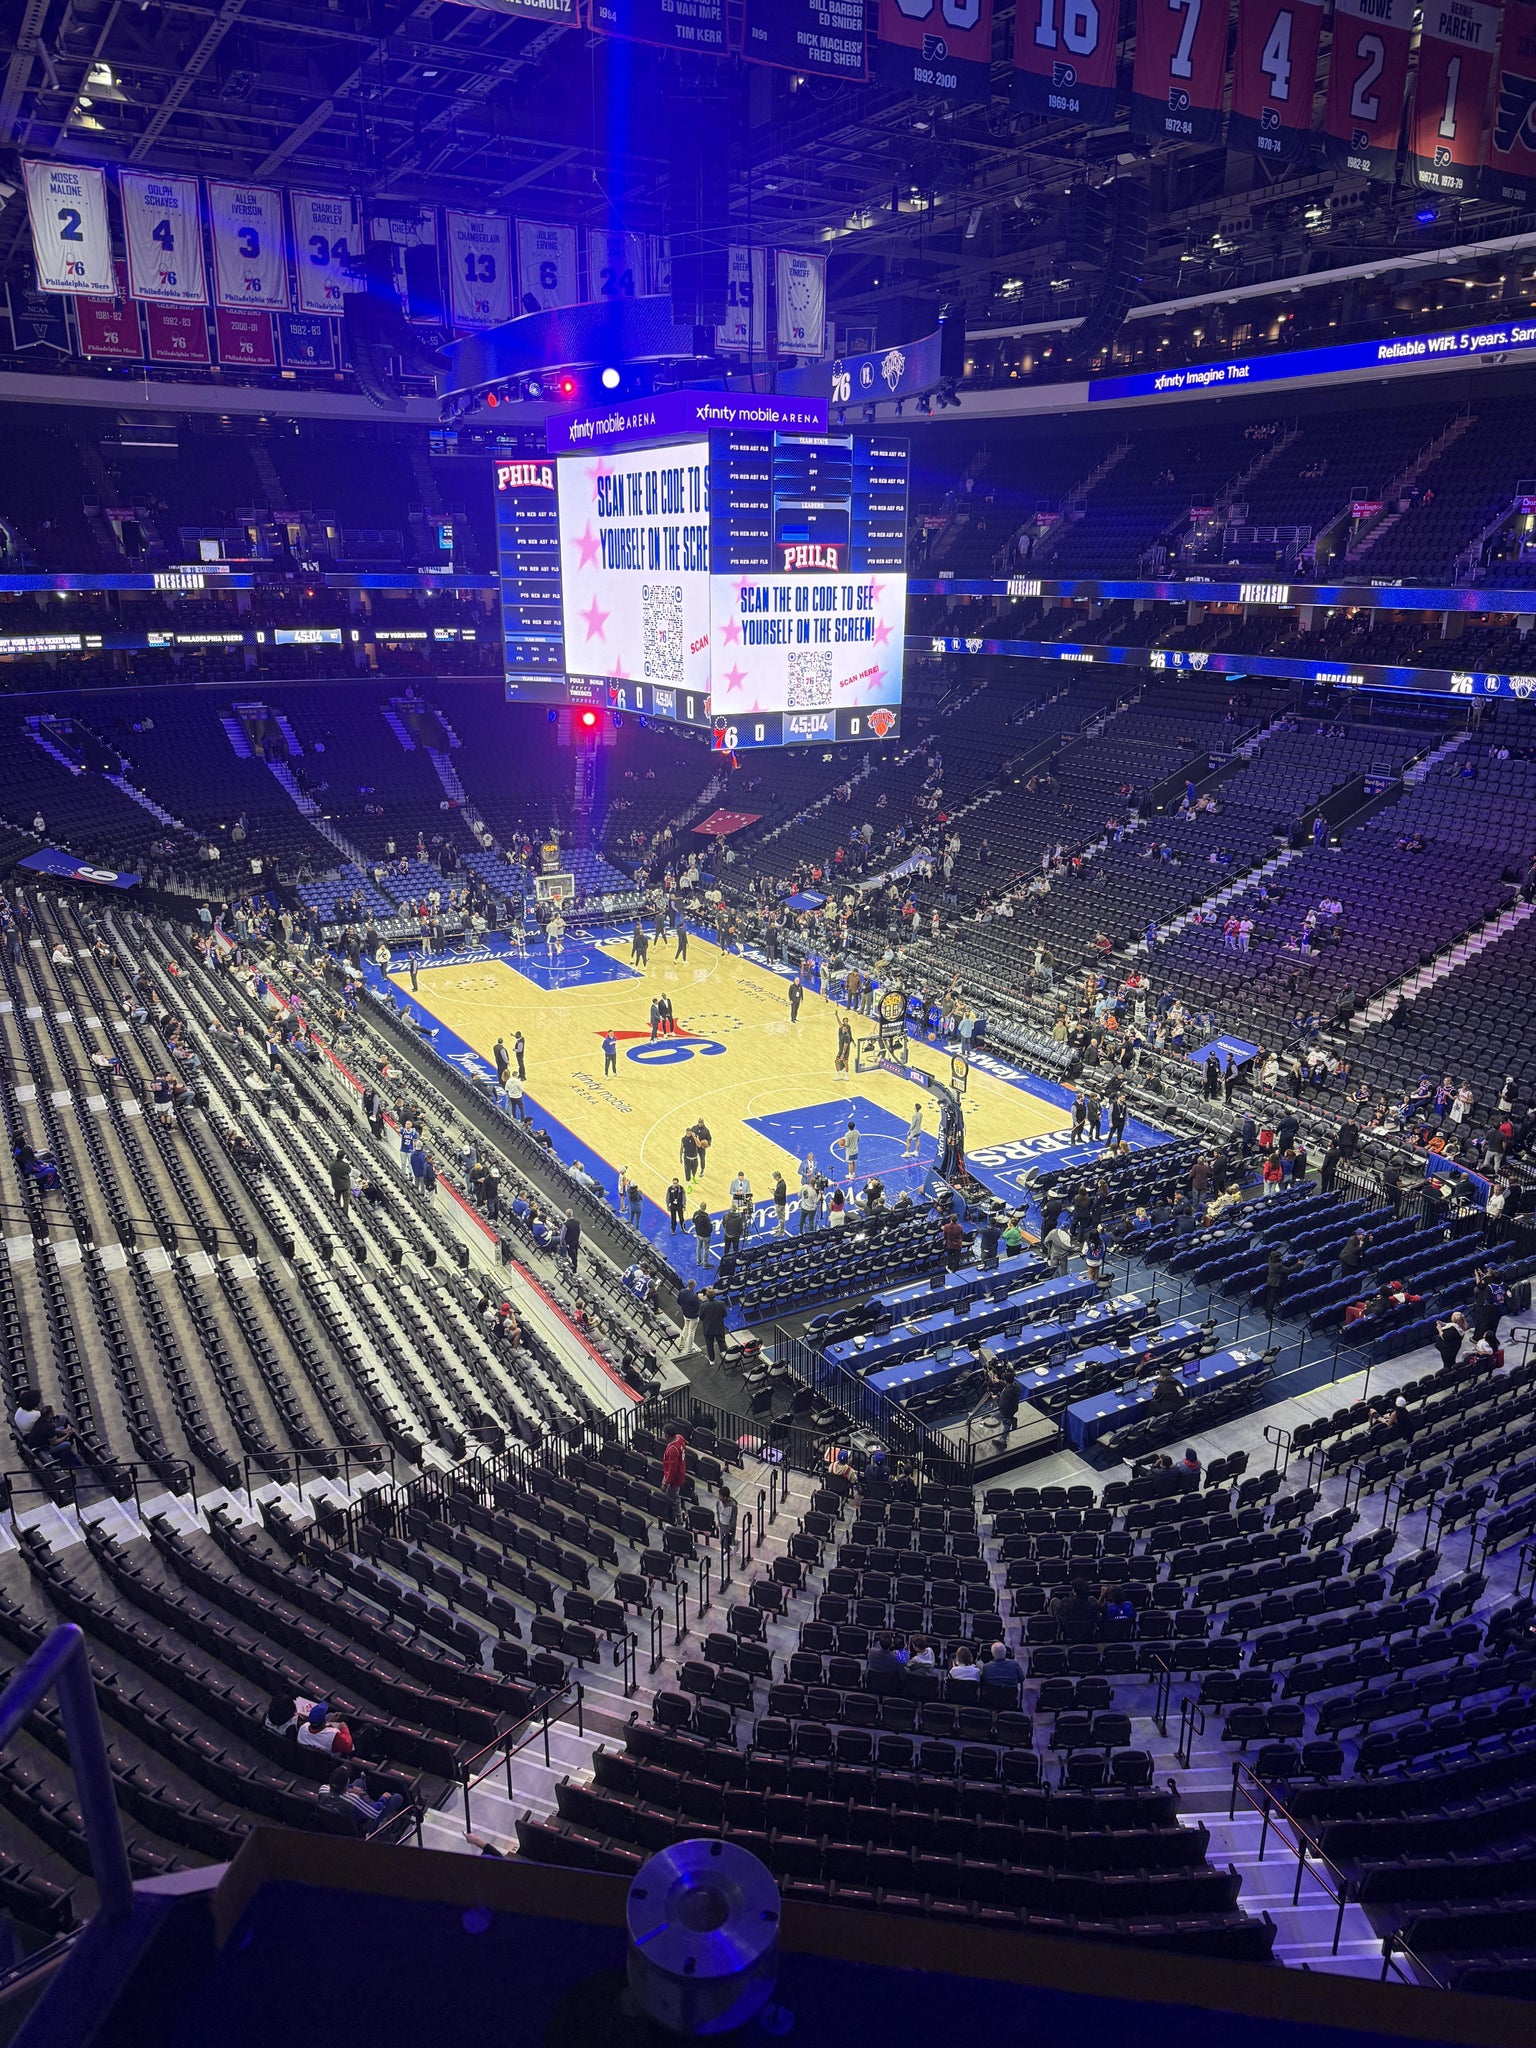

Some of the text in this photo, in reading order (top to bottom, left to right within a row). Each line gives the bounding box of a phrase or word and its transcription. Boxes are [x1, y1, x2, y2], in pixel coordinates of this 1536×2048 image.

[676, 2, 696, 17] VAN
[699, 5, 722, 20] IMPE
[809, 0, 863, 18] BILL BARBER
[1359, 0, 1392, 21] HOWE
[819, 13, 862, 31] ED SNIDER
[1438, 13, 1482, 44] PARENT
[675, 24, 722, 43] TIM KERR
[797, 31, 818, 46] RICK
[1168, 0, 1203, 78] 7
[809, 48, 861, 67] FRED SHERO
[1262, 10, 1293, 100] 4
[1351, 32, 1386, 122] 2
[1048, 94, 1080, 112] 1969-84
[1438, 56, 1462, 138] 1
[1165, 118, 1192, 134] 1972-84
[1257, 136, 1281, 152] 1970-74
[1347, 156, 1371, 172] 1982-92
[50, 172, 79, 184] MOSES
[50, 184, 82, 197] MALONE
[148, 184, 173, 197] DOLPH
[235, 194, 256, 205] ALLEN
[144, 195, 178, 209] SCHAYES
[232, 204, 262, 216] IVERSON
[311, 202, 343, 214] CHARLES
[58, 208, 84, 242] 2
[312, 213, 343, 226] BARKLEY
[152, 219, 174, 251] 4
[238, 227, 260, 259] 3
[457, 231, 500, 244] CHAMBERLAIN
[309, 235, 350, 267] 34
[66, 261, 85, 276] 76
[464, 253, 496, 283] 13
[540, 261, 558, 290] 6
[45, 278, 89, 289] Philadelphia
[159, 271, 177, 286] 76
[244, 278, 262, 292] 76
[600, 268, 635, 296] 24
[324, 285, 341, 299] 76
[95, 311, 122, 321] 1981-82
[474, 301, 490, 313] 76
[735, 324, 747, 335] 76
[793, 328, 805, 339] 76
[1378, 339, 1426, 359] Reliable
[1427, 335, 1457, 353] WiFi.
[1460, 334, 1468, 349] 5
[1470, 332, 1508, 352] years.
[832, 372, 850, 402] 76
[1154, 365, 1250, 390] xfinity Imagine That
[696, 404, 819, 424] xfinity mobile ARENA
[569, 412, 656, 442] xfinity mobile ARENA
[497, 464, 554, 490] PHILA
[597, 474, 624, 517] SCAN
[627, 472, 643, 516] THE
[661, 468, 685, 514] CODE
[688, 466, 700, 513] TO
[600, 528, 645, 570] YOURSELF
[648, 527, 660, 570] ON
[663, 526, 680, 571] THE
[784, 546, 839, 572] PHILA
[154, 574, 204, 589] PRESEASON
[741, 587, 769, 613] SCAN
[773, 586, 791, 612] THE
[812, 586, 838, 611] CODE
[841, 586, 853, 611] TO
[857, 585, 874, 610] SEE
[1240, 584, 1289, 603] PRESEASON
[177, 635, 222, 643] PHILADELPHIA
[256, 632, 265, 643] 0
[352, 630, 359, 641] 0
[742, 617, 875, 645] YOURSELF ON THE SCREEN!
[690, 635, 709, 654] SCAN
[1150, 653, 1166, 668] 76
[839, 665, 880, 688] SCAN HERE!
[1450, 676, 1473, 694] 76
[609, 688, 626, 709] 76
[636, 687, 643, 708] 0
[687, 696, 694, 718] 0
[713, 715, 860, 749] 76 0 45:04 0
[387, 951, 516, 971] Phladelphia
[570, 1085, 599, 1105] ARENA
